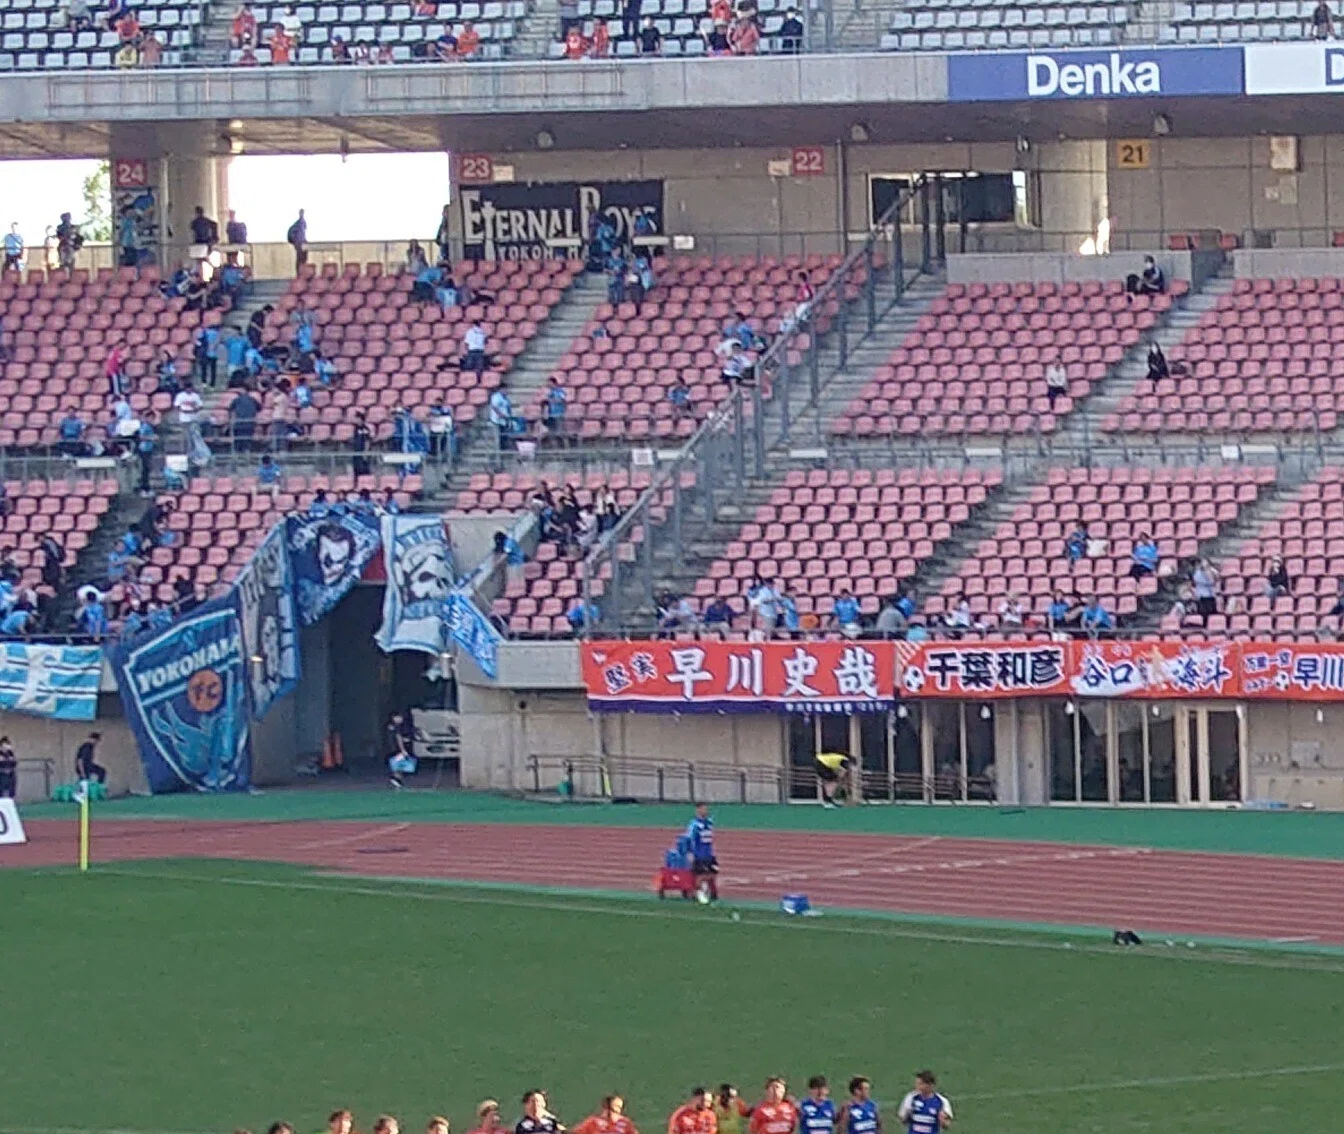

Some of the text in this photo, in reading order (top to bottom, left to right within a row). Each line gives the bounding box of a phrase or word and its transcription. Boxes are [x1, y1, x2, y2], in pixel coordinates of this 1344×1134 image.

[1026, 53, 1161, 96] Denka
[462, 158, 491, 178] 23
[797, 148, 822, 172] 22
[1121, 144, 1145, 164] 21
[119, 163, 144, 183] 24
[461, 189, 579, 262] ETERNAL
[665, 645, 879, 700] 早川史哉
[927, 648, 1063, 689] 千葉和彦
